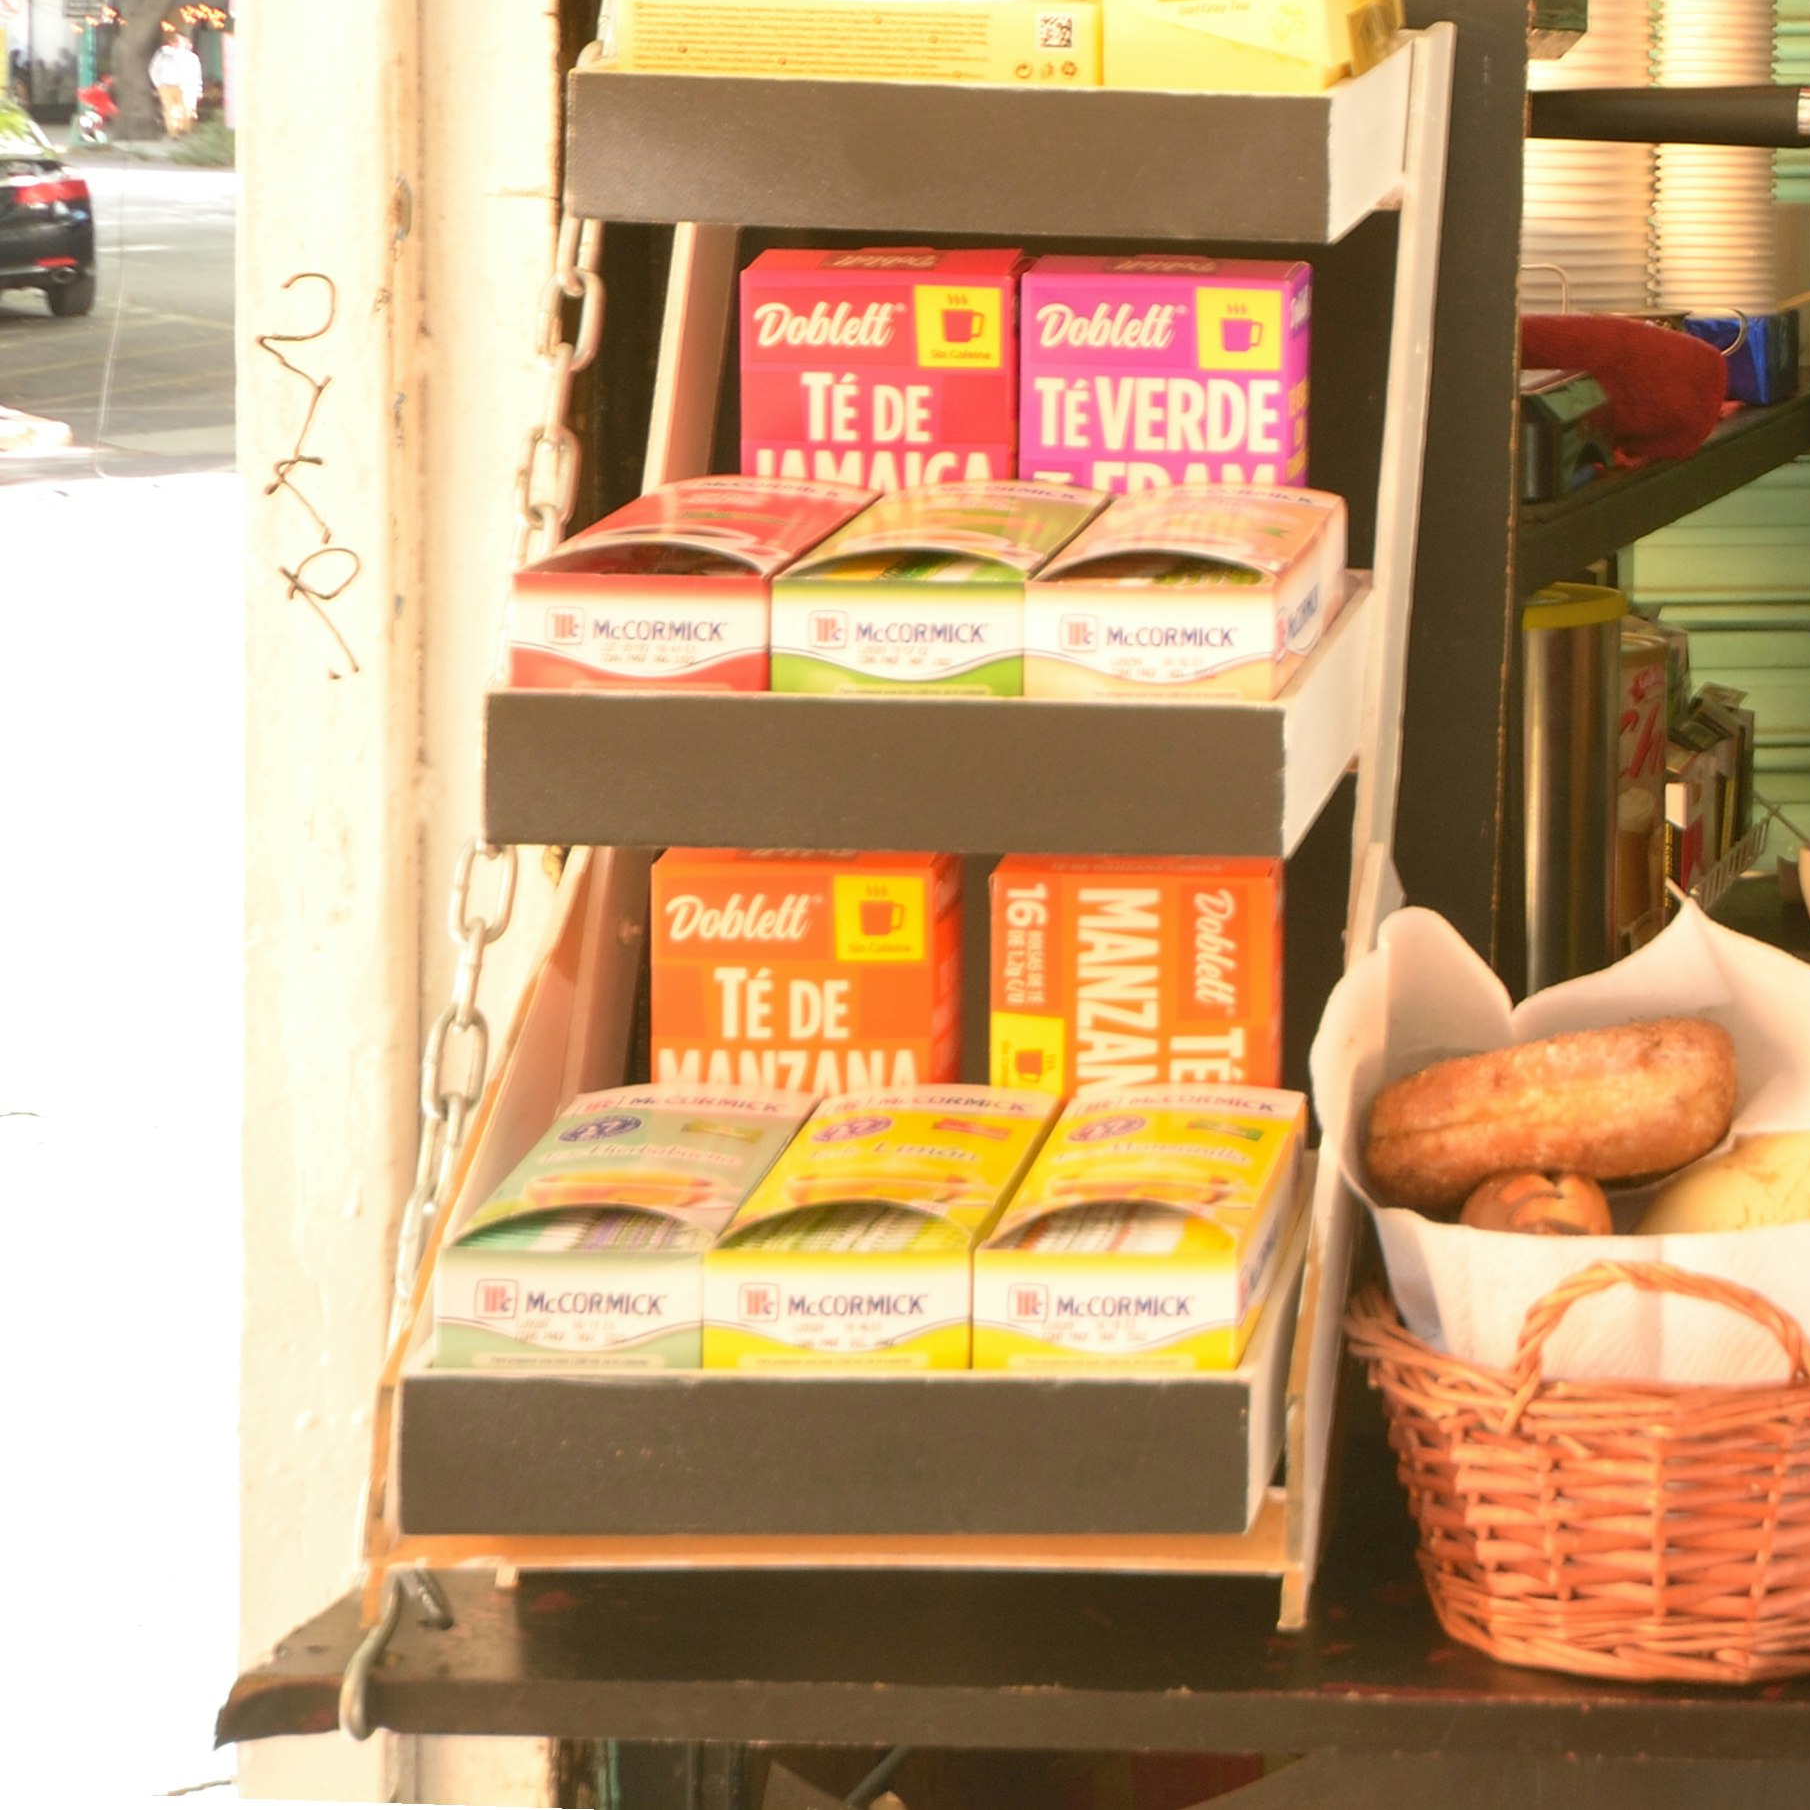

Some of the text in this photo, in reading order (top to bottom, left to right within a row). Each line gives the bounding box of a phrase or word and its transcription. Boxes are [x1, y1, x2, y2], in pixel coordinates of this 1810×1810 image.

[754, 301, 893, 347] Doblett
[1036, 301, 1176, 349] Doblett
[801, 370, 932, 443] TÉ DE
[1034, 375, 1281, 453] TÉ VERDE
[593, 619, 728, 642] McCORMICK
[856, 622, 987, 644] McCORMICK
[1106, 625, 1237, 648] McCORMICK
[665, 892, 809, 941] Doblett
[1005, 882, 1048, 927] 16
[1007, 930, 1026, 947] DE
[1194, 888, 1237, 1006] Doblett
[714, 966, 850, 1040] TÉ DE
[1077, 888, 1160, 1096] MANZAN
[659, 1047, 919, 1094] MANZANA
[525, 1291, 664, 1316] McCORMICK
[788, 1294, 926, 1317] McCORMICK
[1057, 1295, 1192, 1317] McCORMICK
